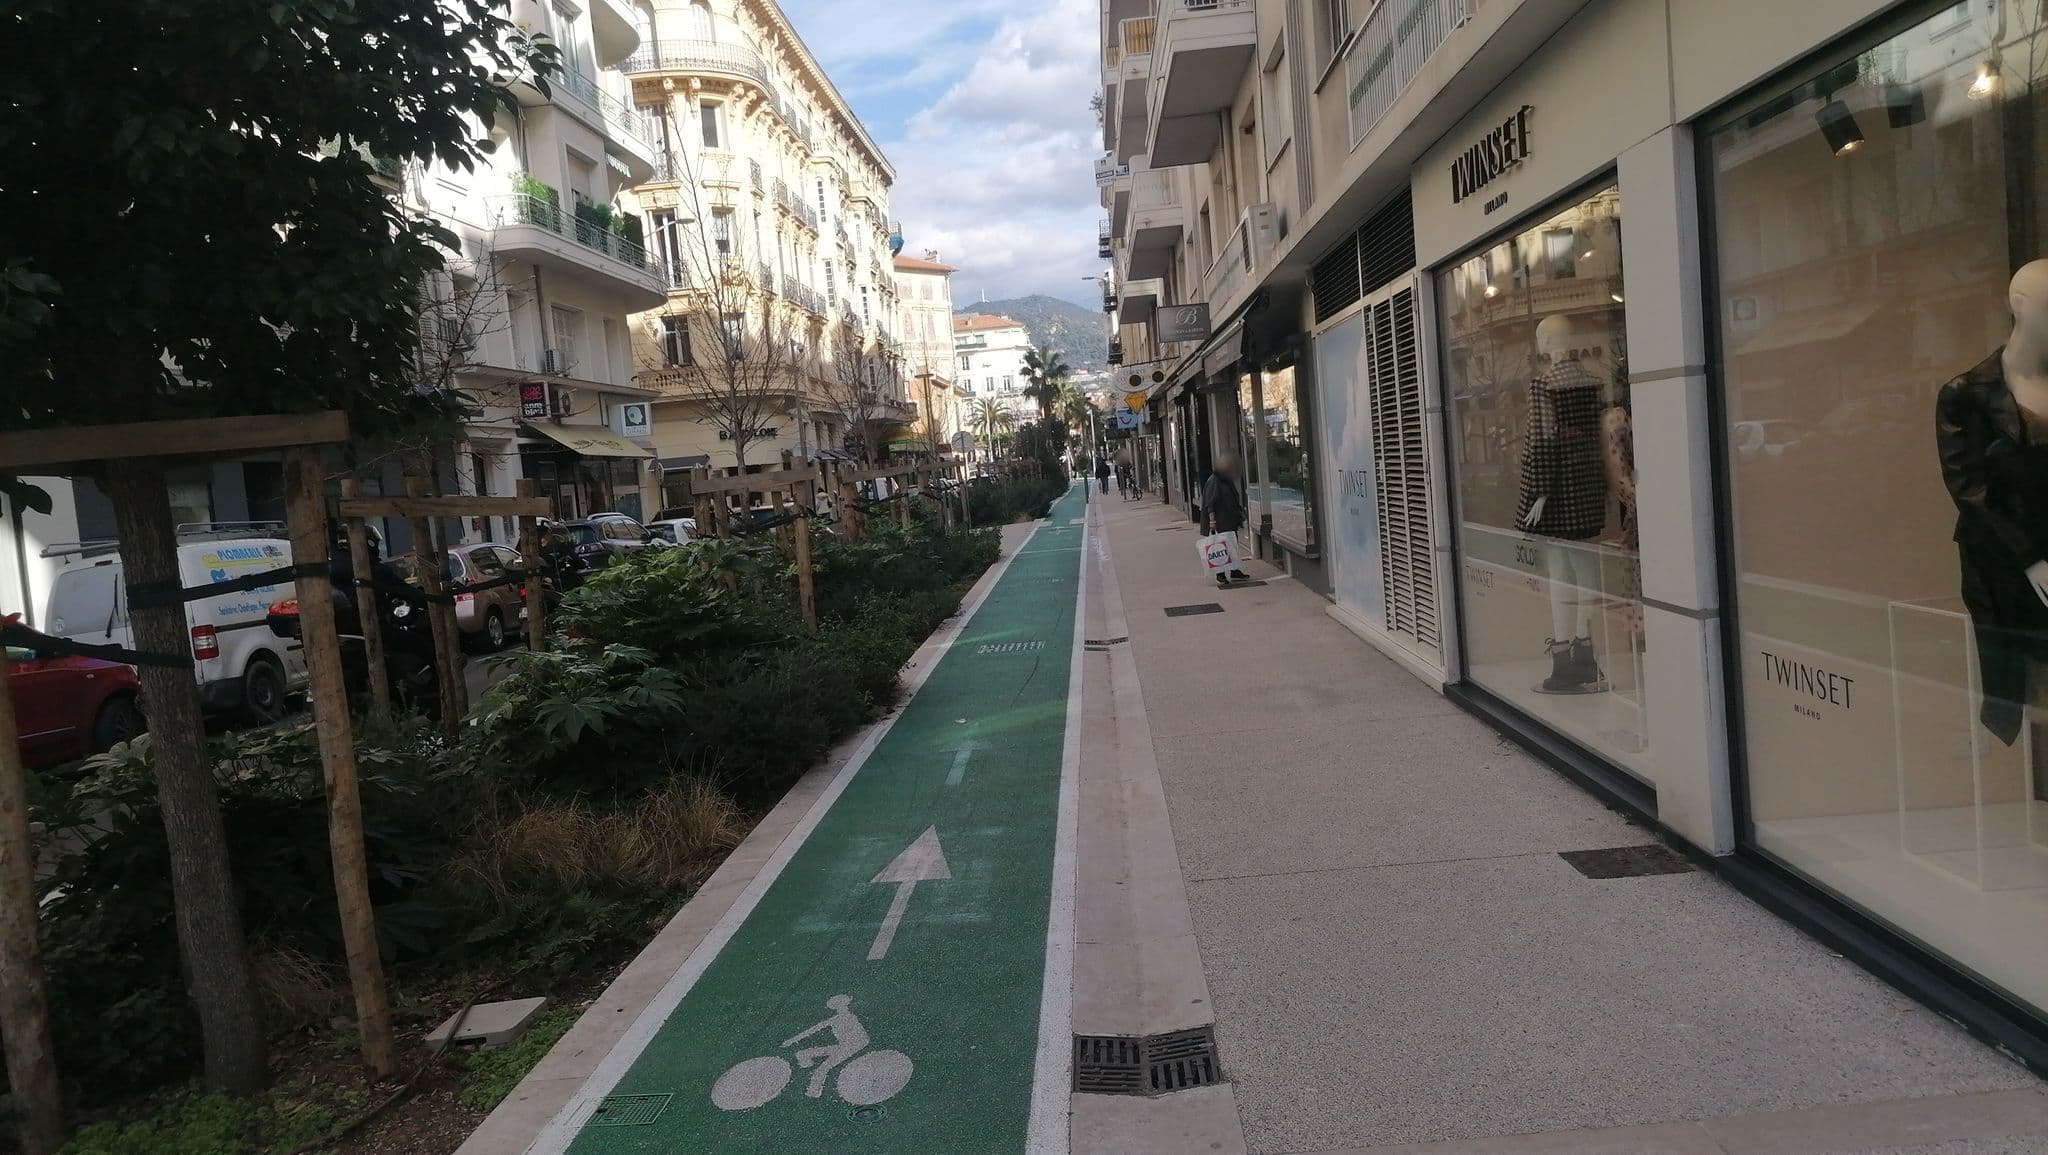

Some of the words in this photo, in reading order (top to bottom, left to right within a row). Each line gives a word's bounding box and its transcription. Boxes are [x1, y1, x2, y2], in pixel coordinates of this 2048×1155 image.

[1449, 105, 1534, 204] TWINSET
[1338, 469, 1367, 498] TWINSET
[1465, 565, 1494, 588] TWINSET
[1761, 651, 1854, 709] TWINSET
[1794, 704, 1821, 720] MILANO
